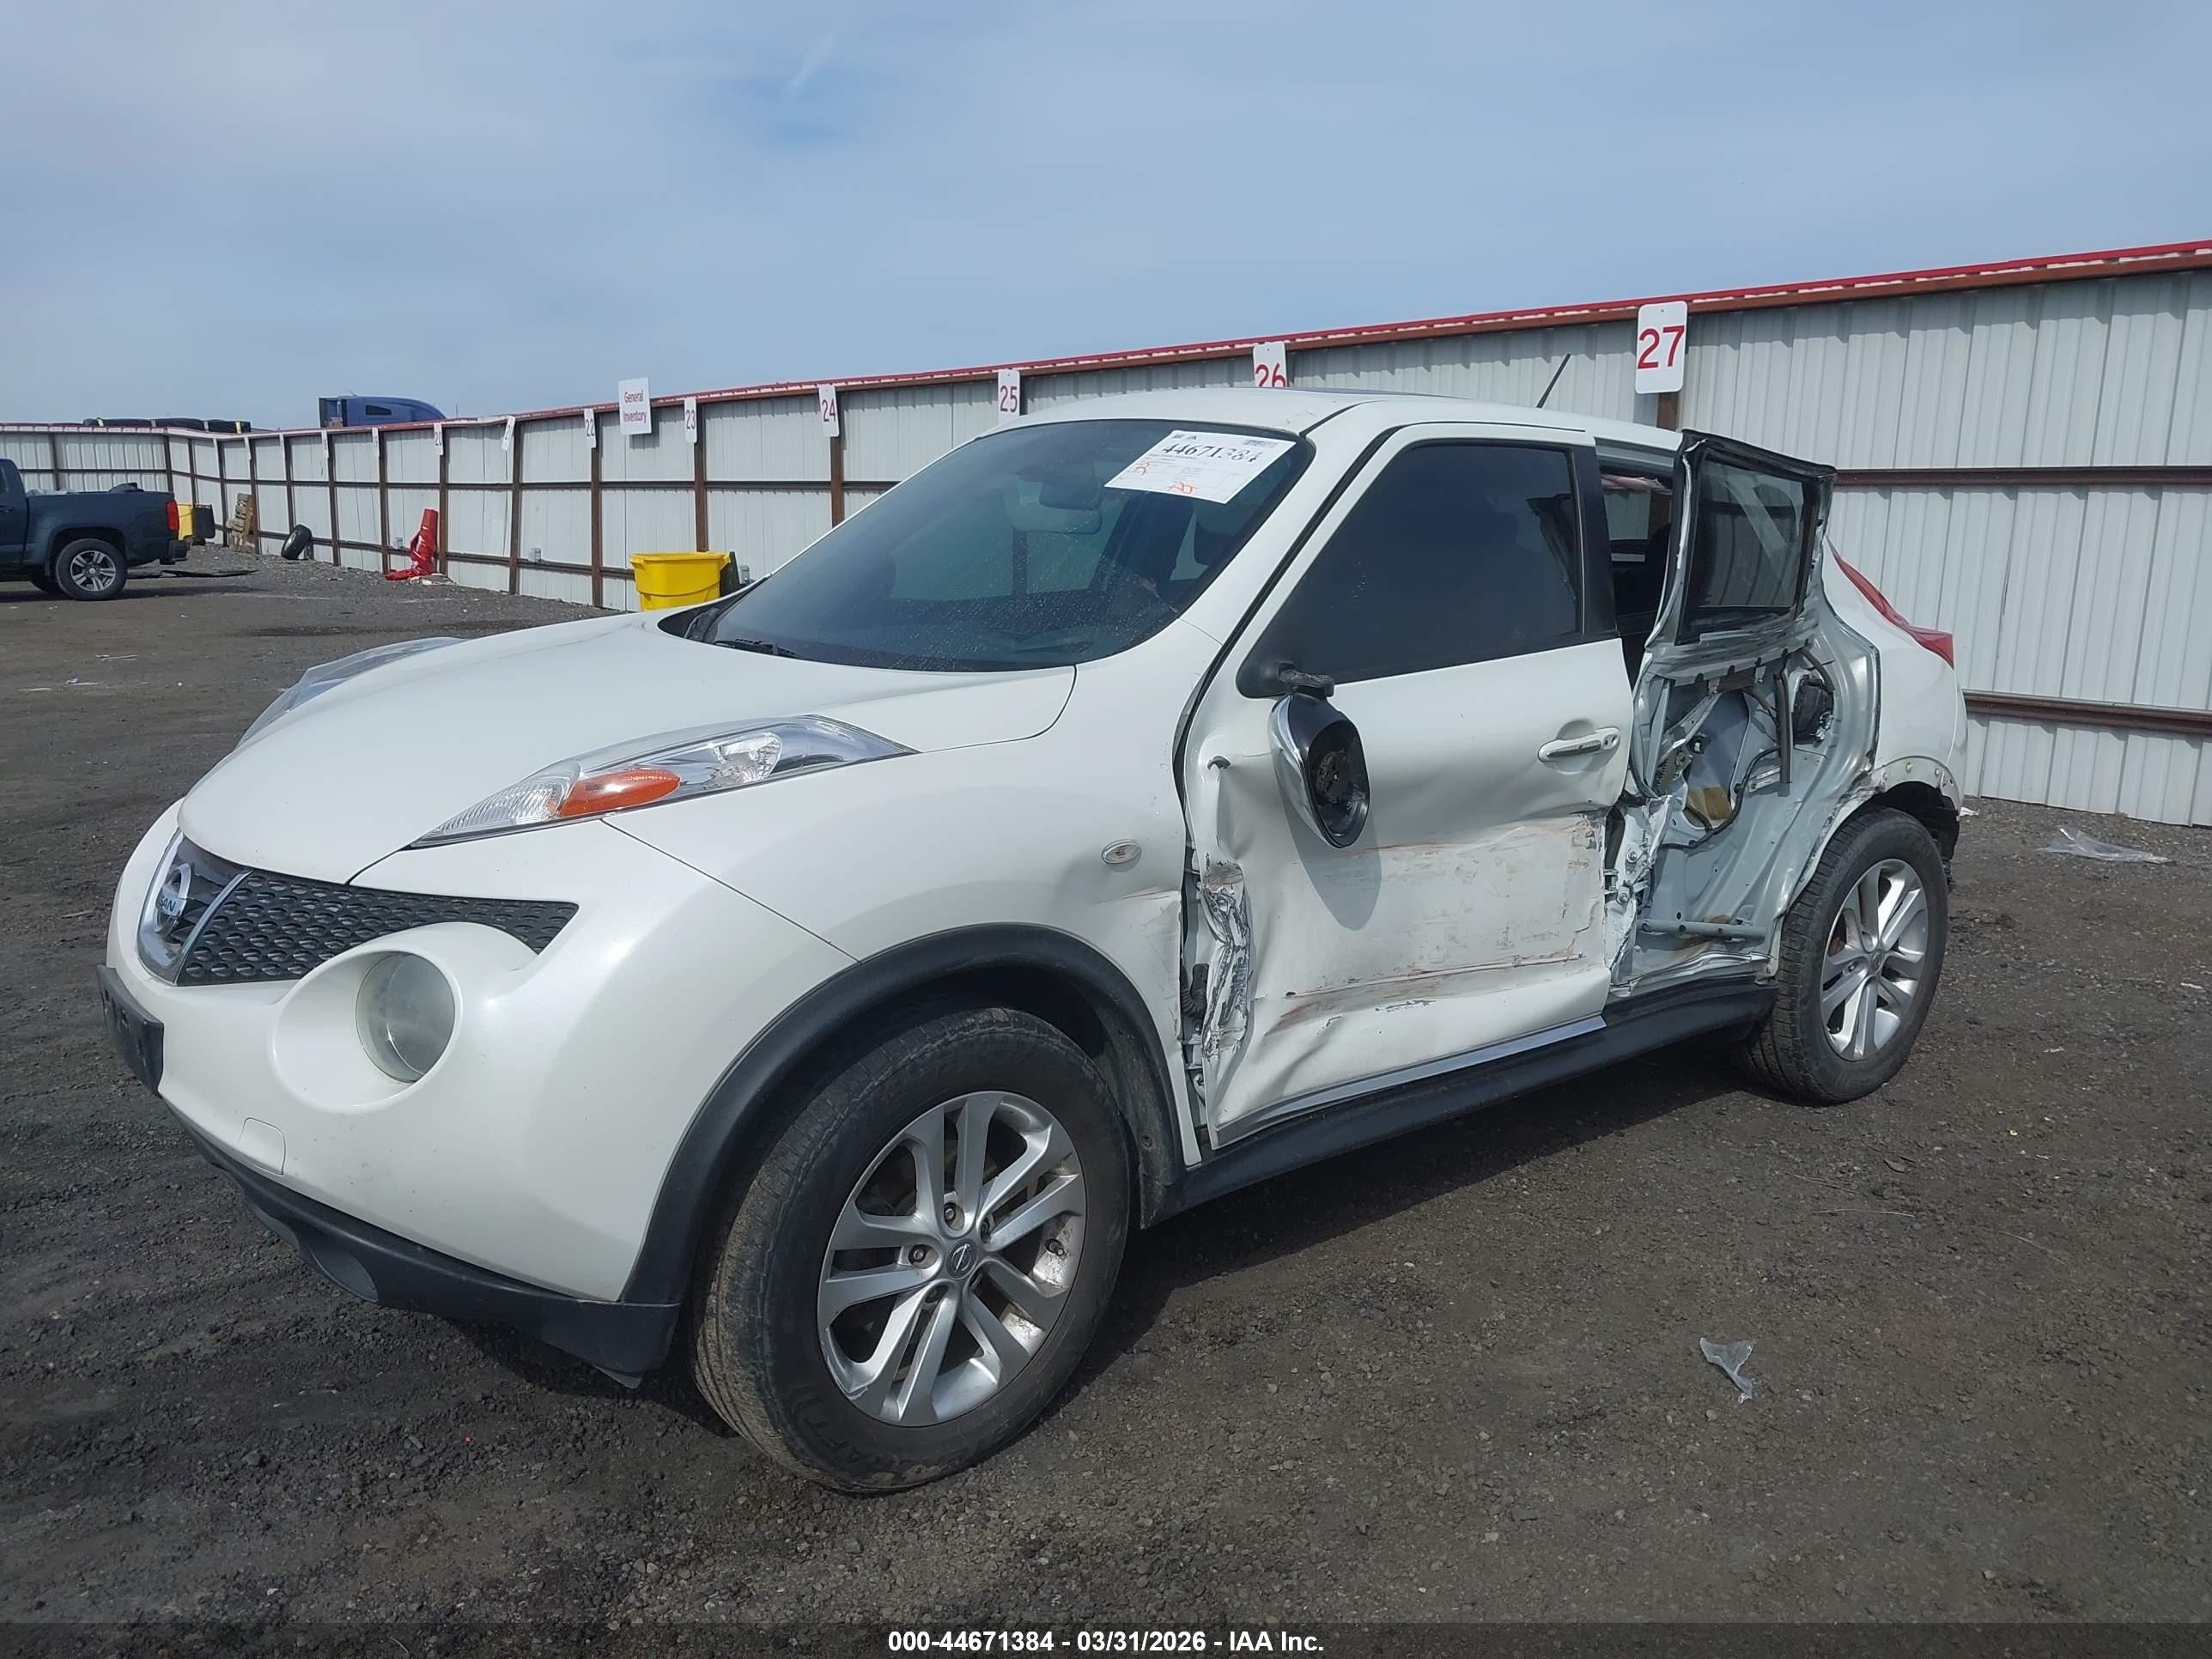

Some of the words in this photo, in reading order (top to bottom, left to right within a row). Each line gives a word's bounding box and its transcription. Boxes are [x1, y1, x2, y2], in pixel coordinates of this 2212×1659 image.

[1638, 325, 1685, 369] 27
[1255, 362, 1286, 387] 26
[624, 389, 644, 403] General
[1000, 385, 1018, 413] 25
[623, 411, 647, 423] Inventory
[686, 410, 696, 429] 23
[822, 398, 836, 422] 24
[586, 419, 595, 436] 22
